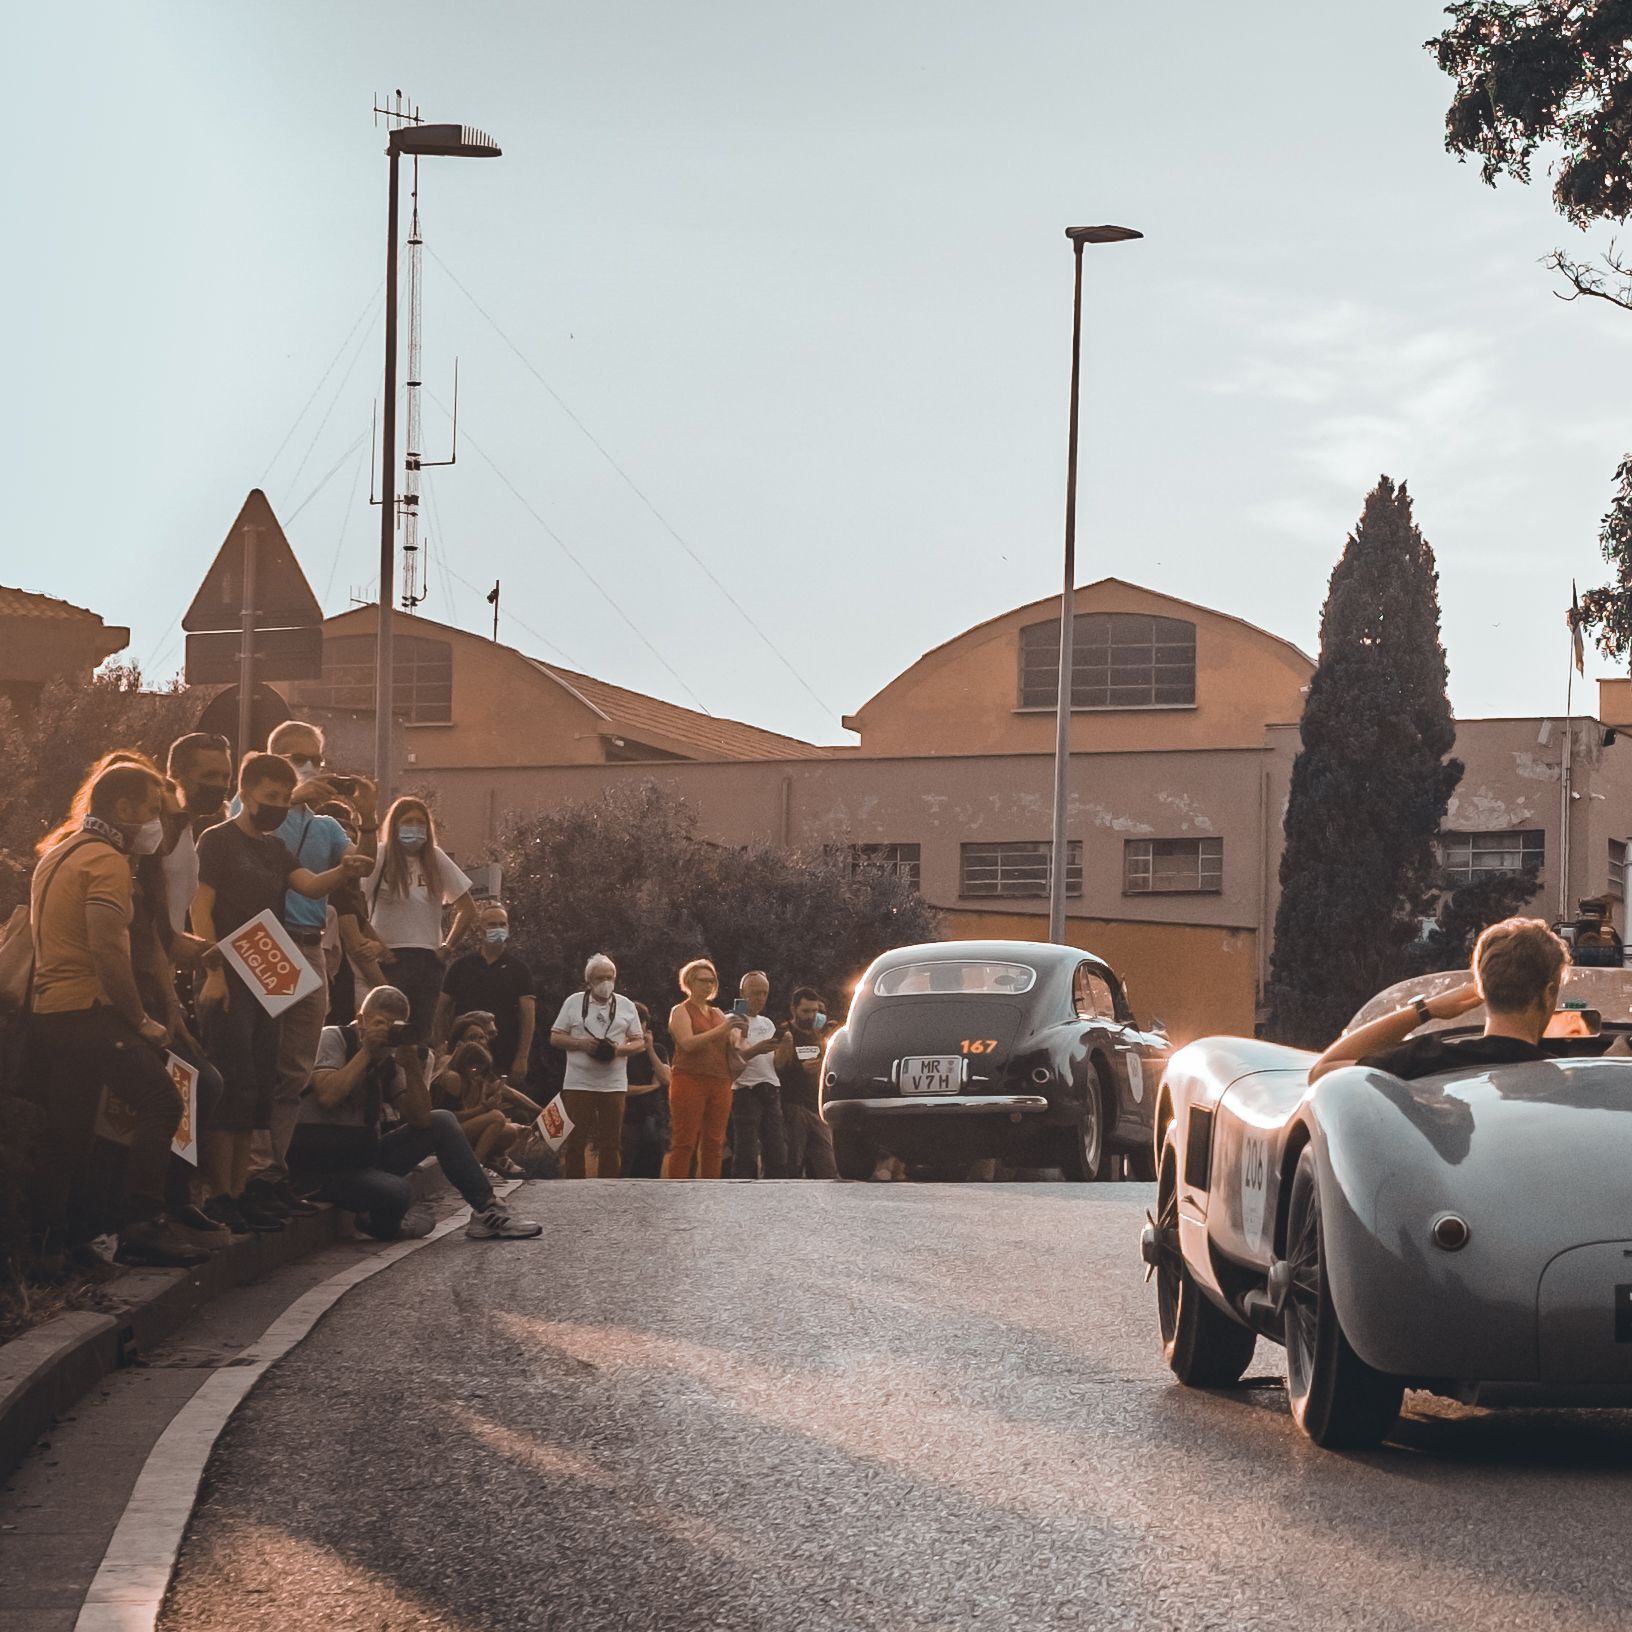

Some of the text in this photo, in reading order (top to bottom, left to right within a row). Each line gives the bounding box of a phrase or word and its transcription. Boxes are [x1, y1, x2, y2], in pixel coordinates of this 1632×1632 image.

[234, 939, 277, 989] MIGLIA
[254, 931, 290, 974] 1000
[921, 1060, 940, 1074] MR
[961, 1040, 998, 1054] 167
[1245, 1136, 1264, 1191] 206
